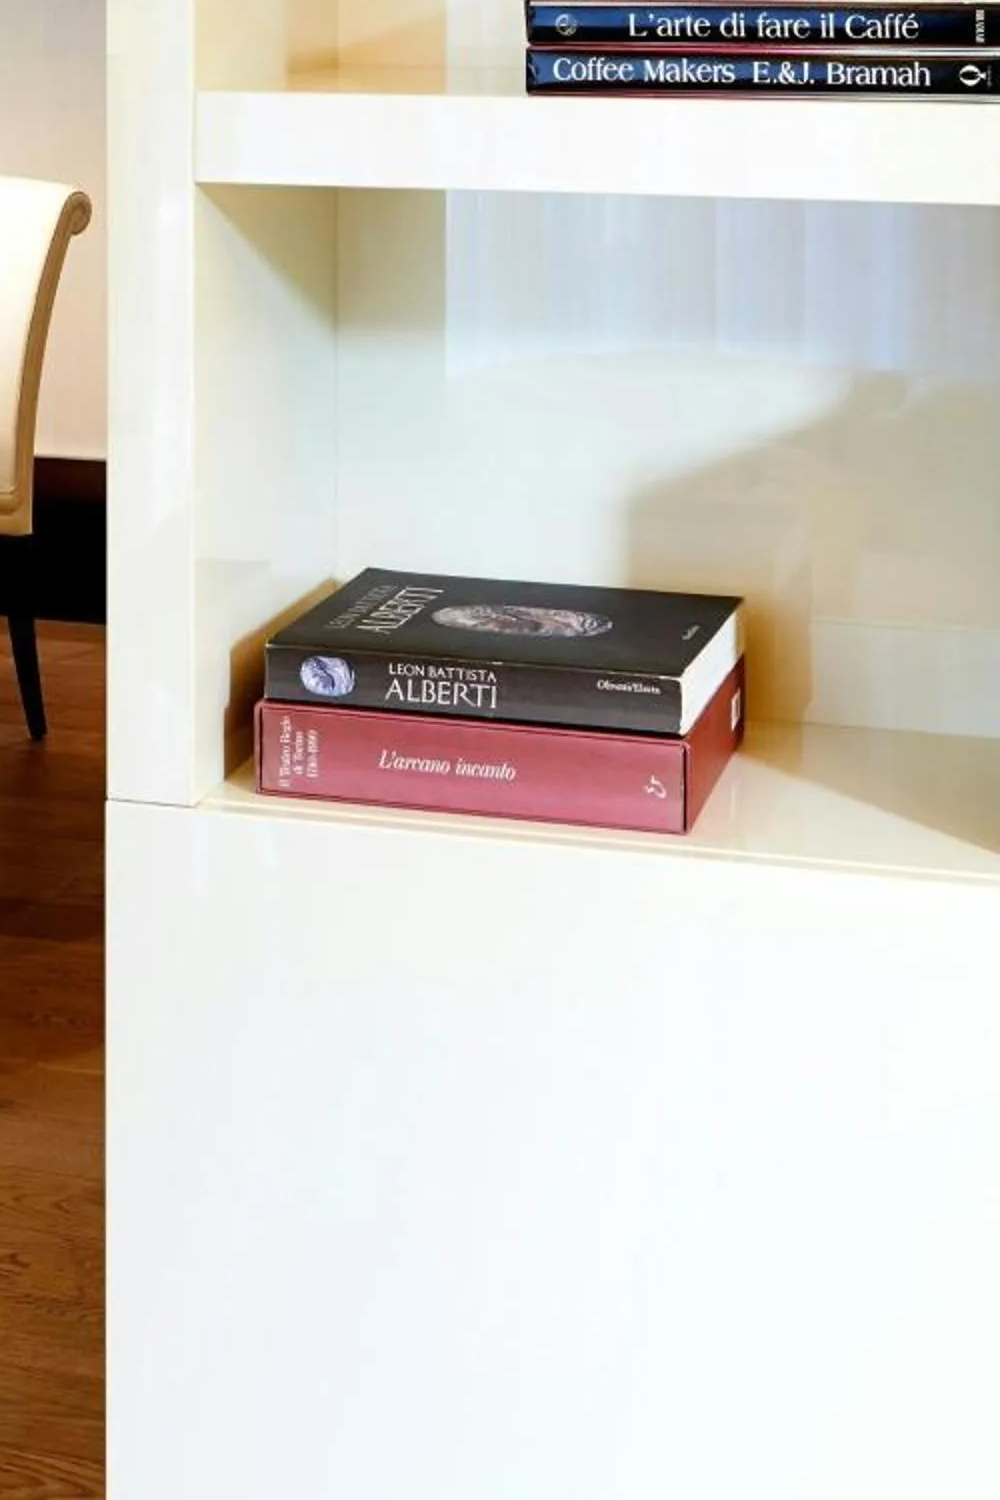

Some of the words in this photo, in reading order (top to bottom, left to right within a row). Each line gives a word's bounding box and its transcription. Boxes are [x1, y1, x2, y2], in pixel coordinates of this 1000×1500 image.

[628, 11, 711, 38] L'arte
[719, 11, 746, 38] di
[756, 11, 811, 39] fare
[820, 11, 836, 39] il
[845, 10, 920, 40] Caffé
[553, 56, 634, 82] Coffee
[642, 57, 736, 83] Makers
[752, 60, 815, 85] E.&J.
[826, 61, 931, 87] Bramah
[389, 661, 425, 677] LEON
[428, 665, 498, 684] BATTISTA
[385, 678, 498, 709] ALBERTI
